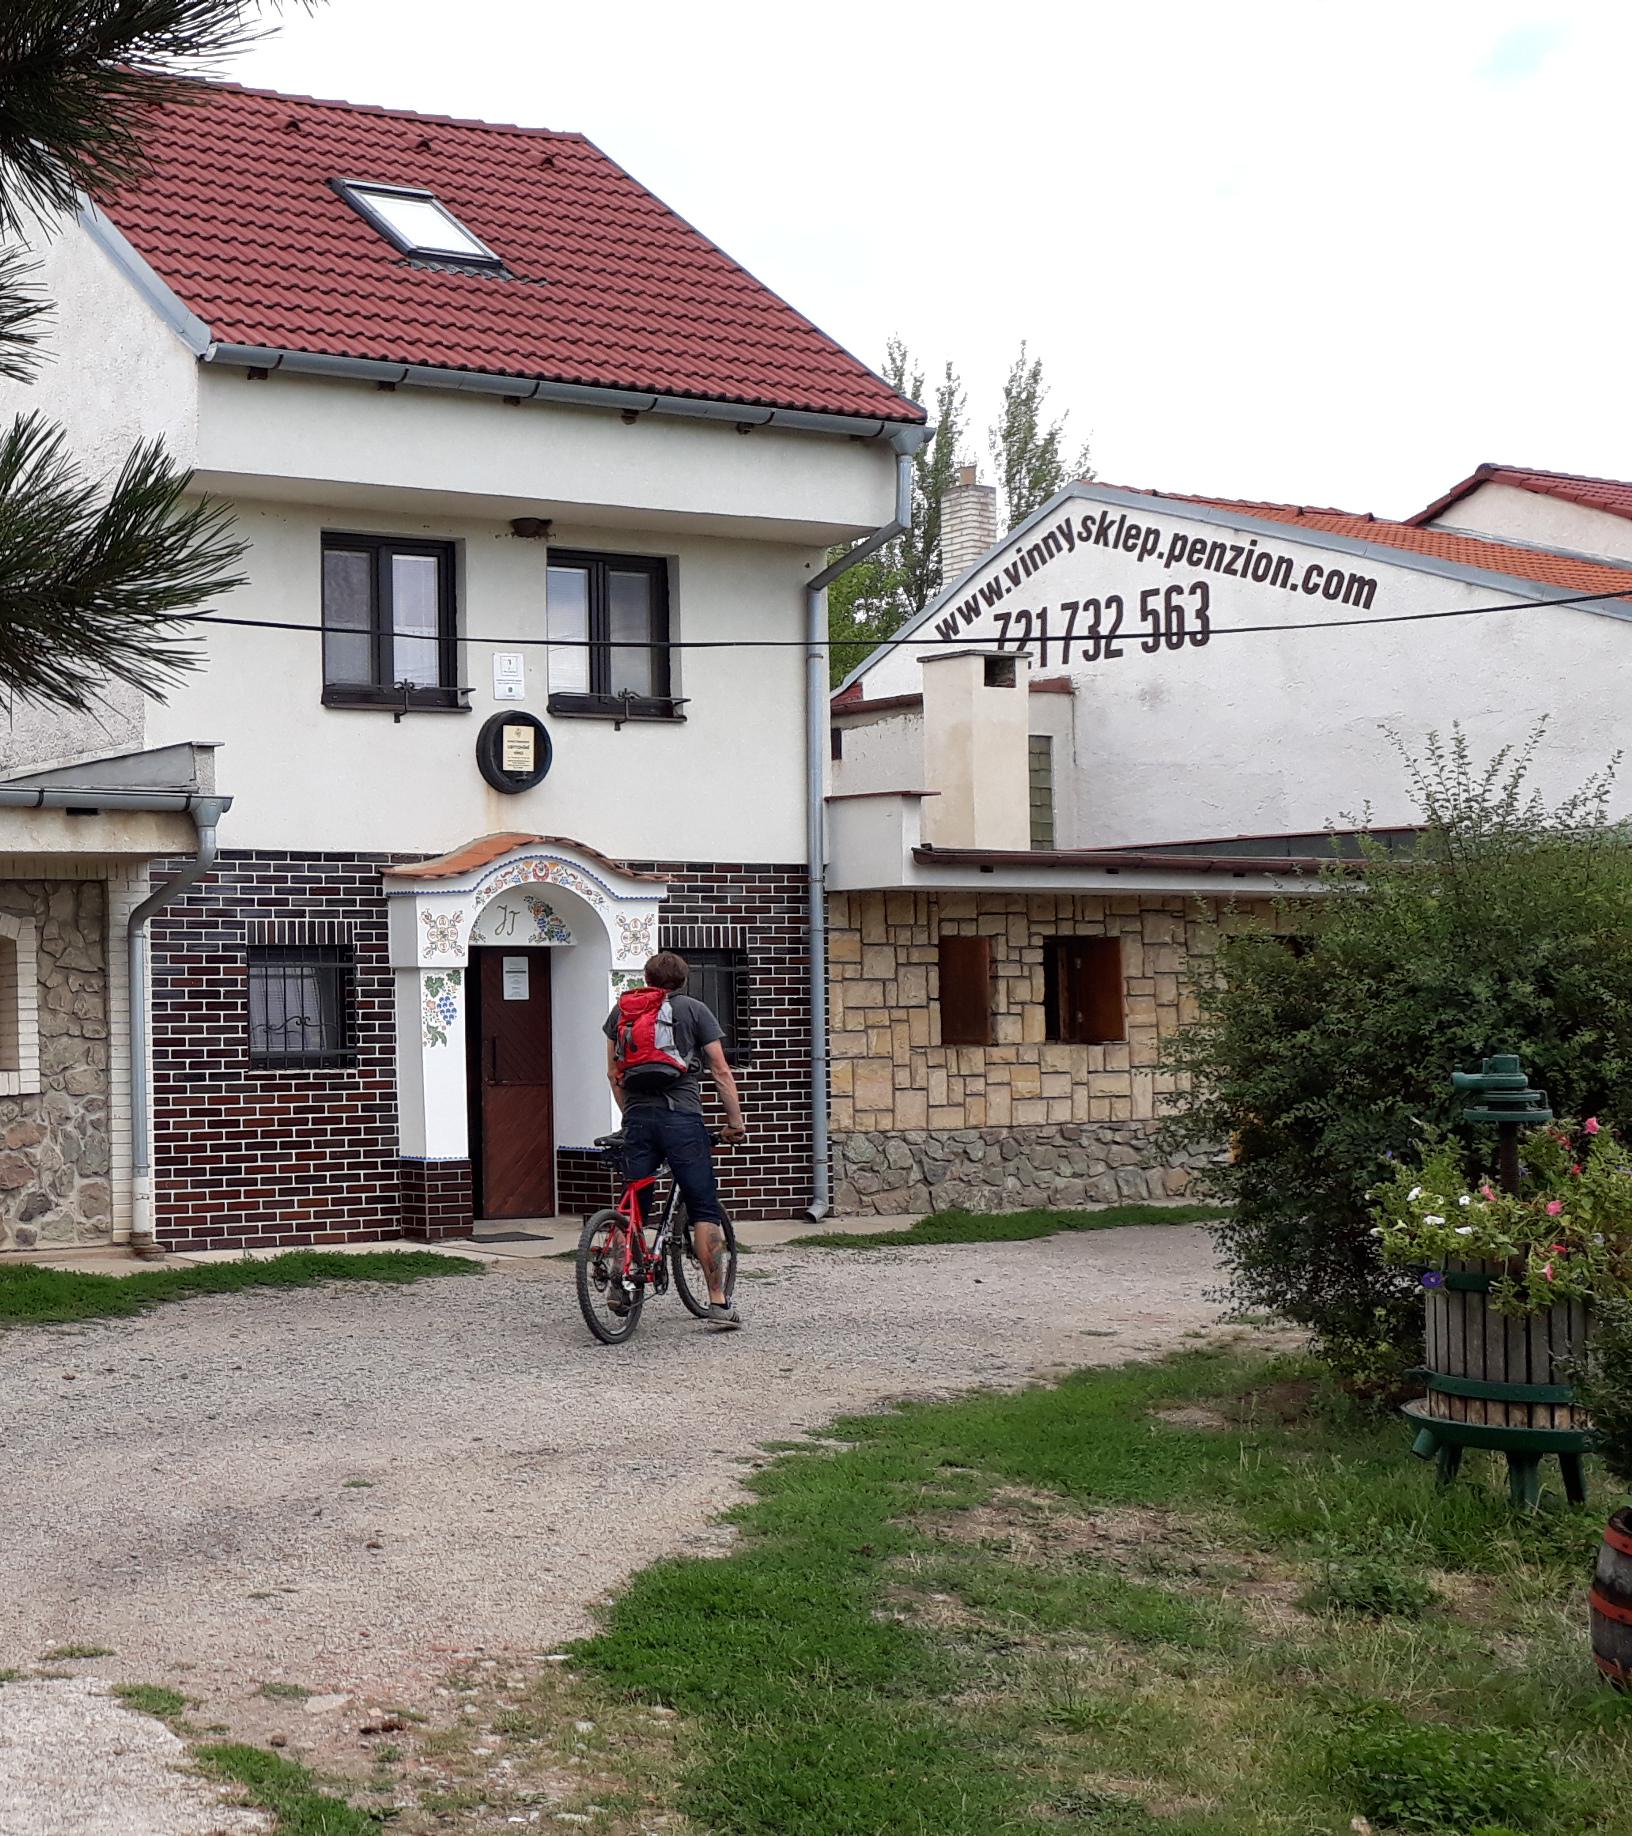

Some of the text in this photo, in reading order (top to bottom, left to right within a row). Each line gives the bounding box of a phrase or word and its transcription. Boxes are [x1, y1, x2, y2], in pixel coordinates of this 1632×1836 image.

[934, 510, 1378, 641] www.vinnysklep.penzion.com
[993, 581, 1211, 669] 721 732 563
